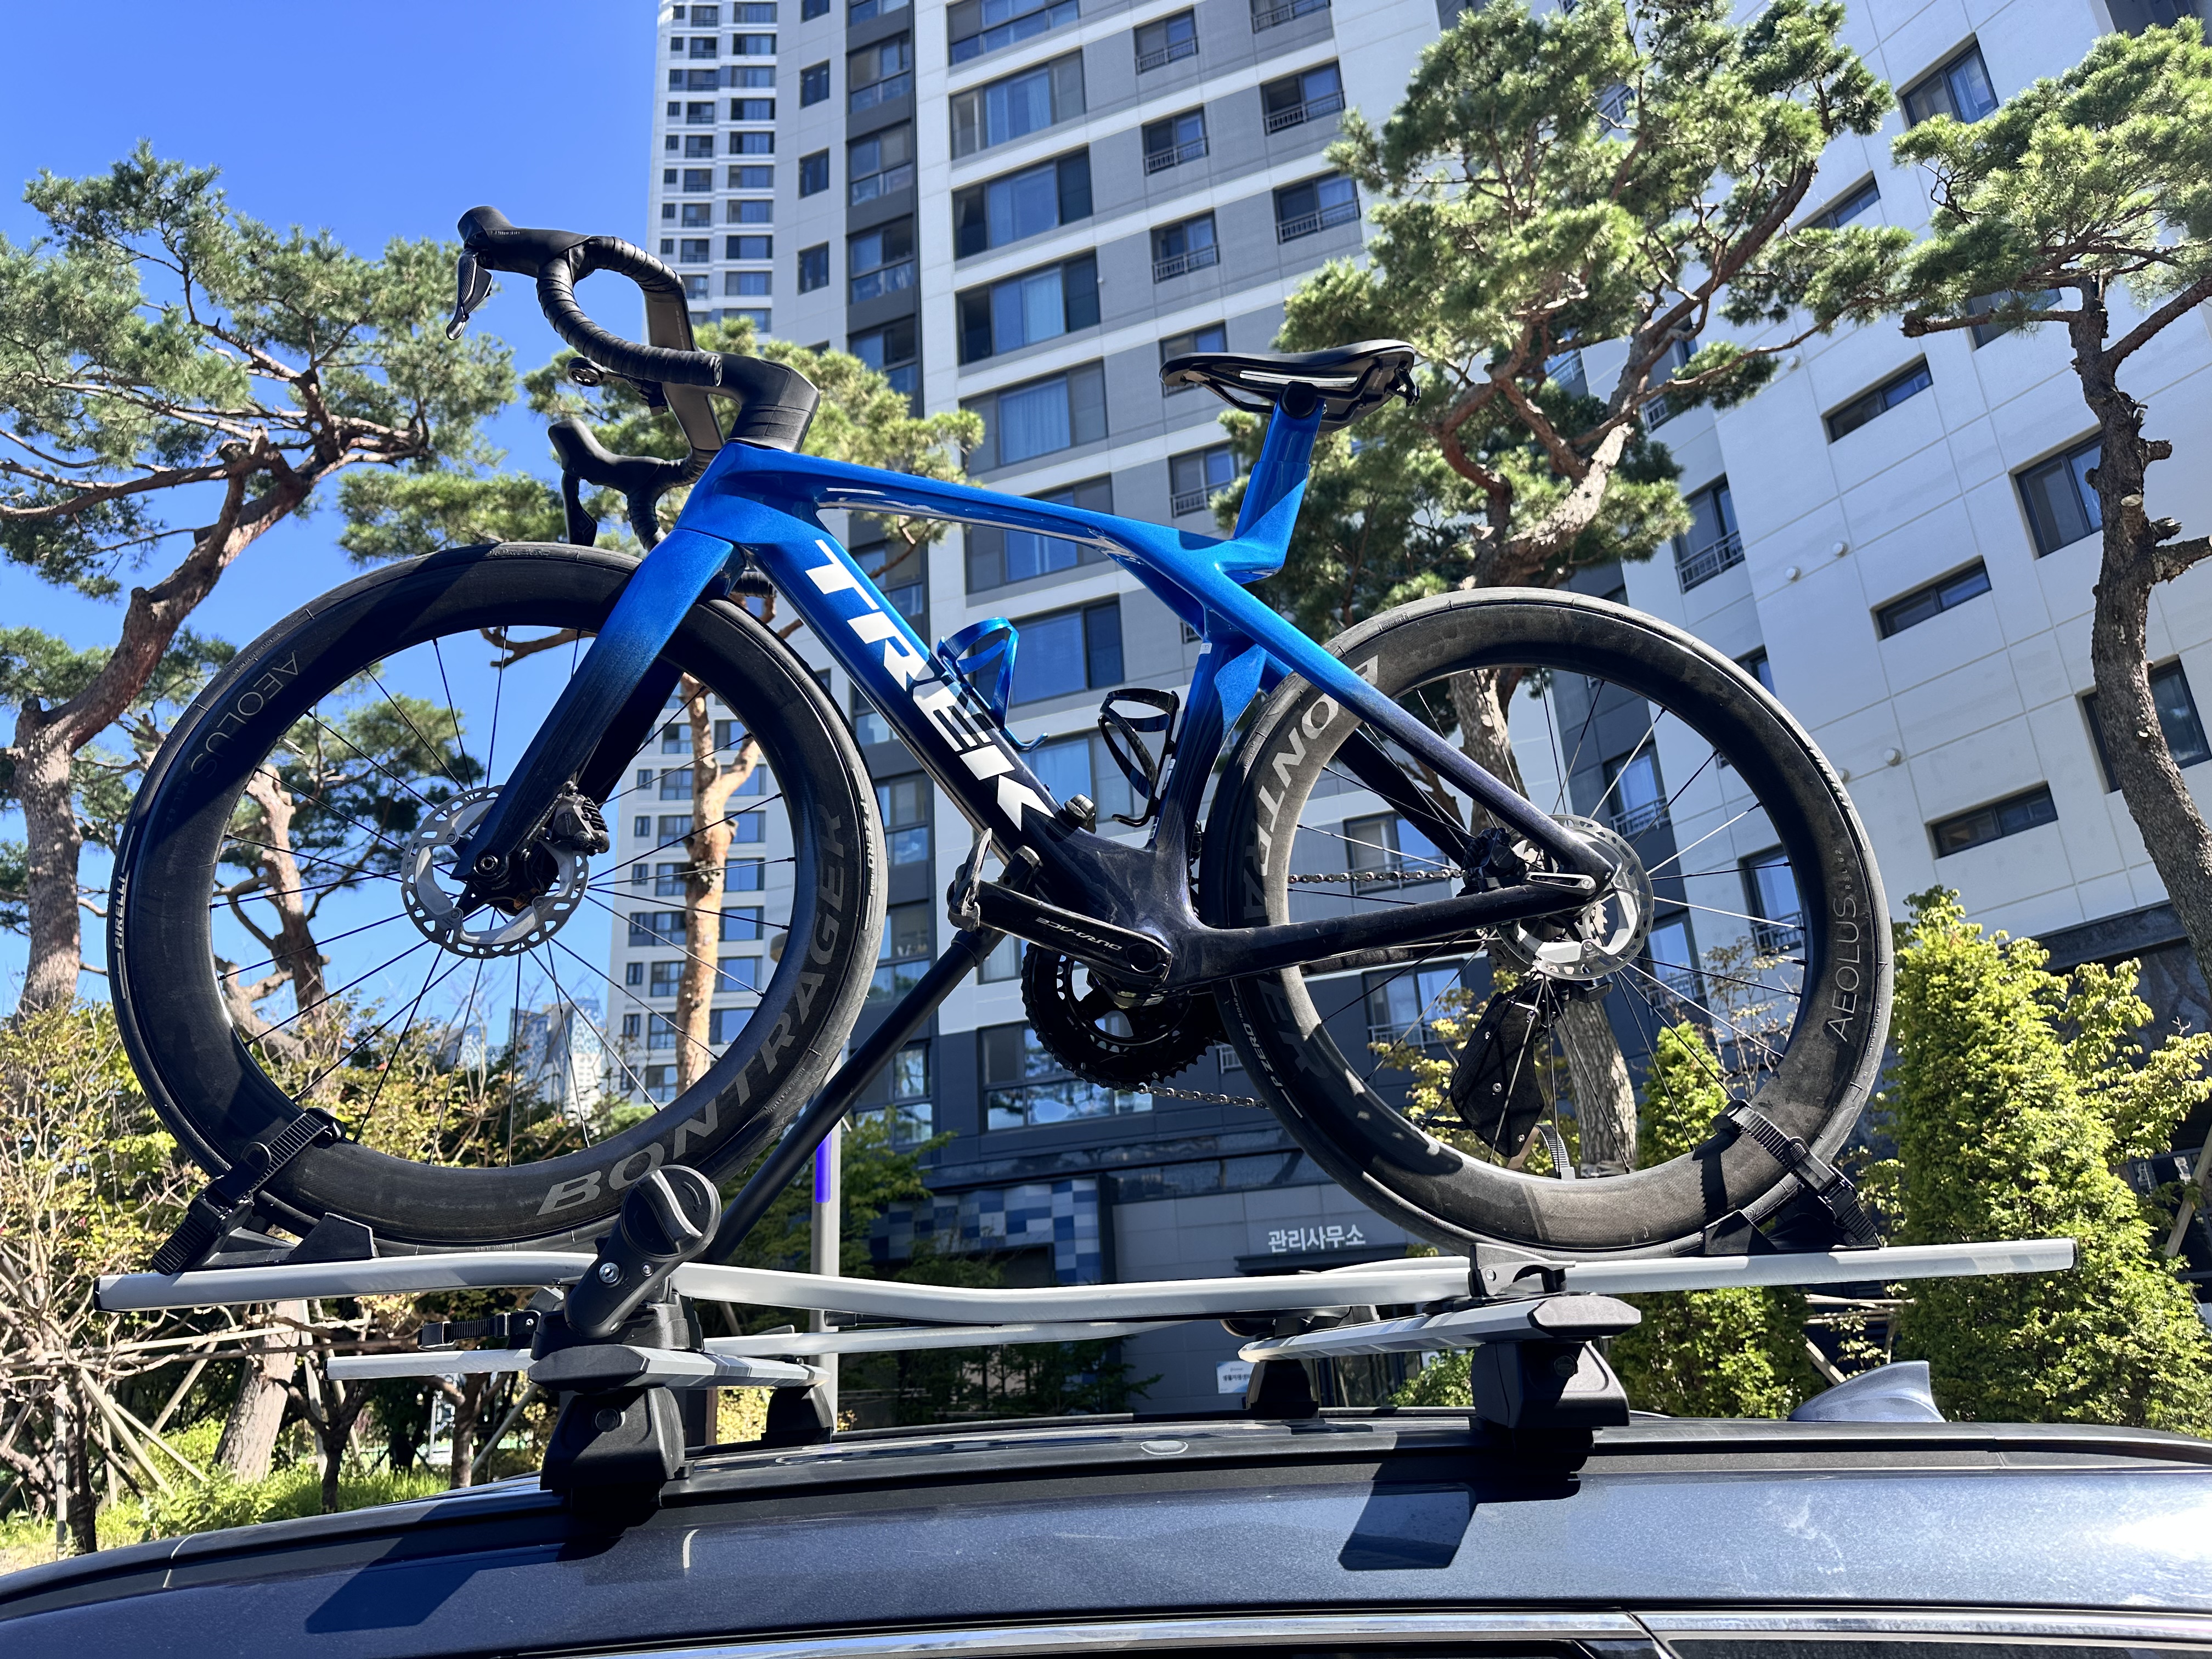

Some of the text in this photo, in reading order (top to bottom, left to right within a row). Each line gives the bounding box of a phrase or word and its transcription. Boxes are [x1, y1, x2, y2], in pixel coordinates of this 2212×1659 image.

[190, 651, 298, 778] AEOLUS
[805, 539, 1055, 831] TREK
[1809, 749, 1849, 806] PIRELLI
[863, 817, 873, 870] ZERO
[114, 876, 126, 949] PIRELLI
[1035, 917, 1122, 951] DURA-ACE
[1827, 896, 1860, 1042] AEOLUS
[537, 804, 845, 1216] BONTRAGER
[1243, 1023, 1273, 1073] ZERO
[1268, 1224, 1366, 1253] 관리사무소
